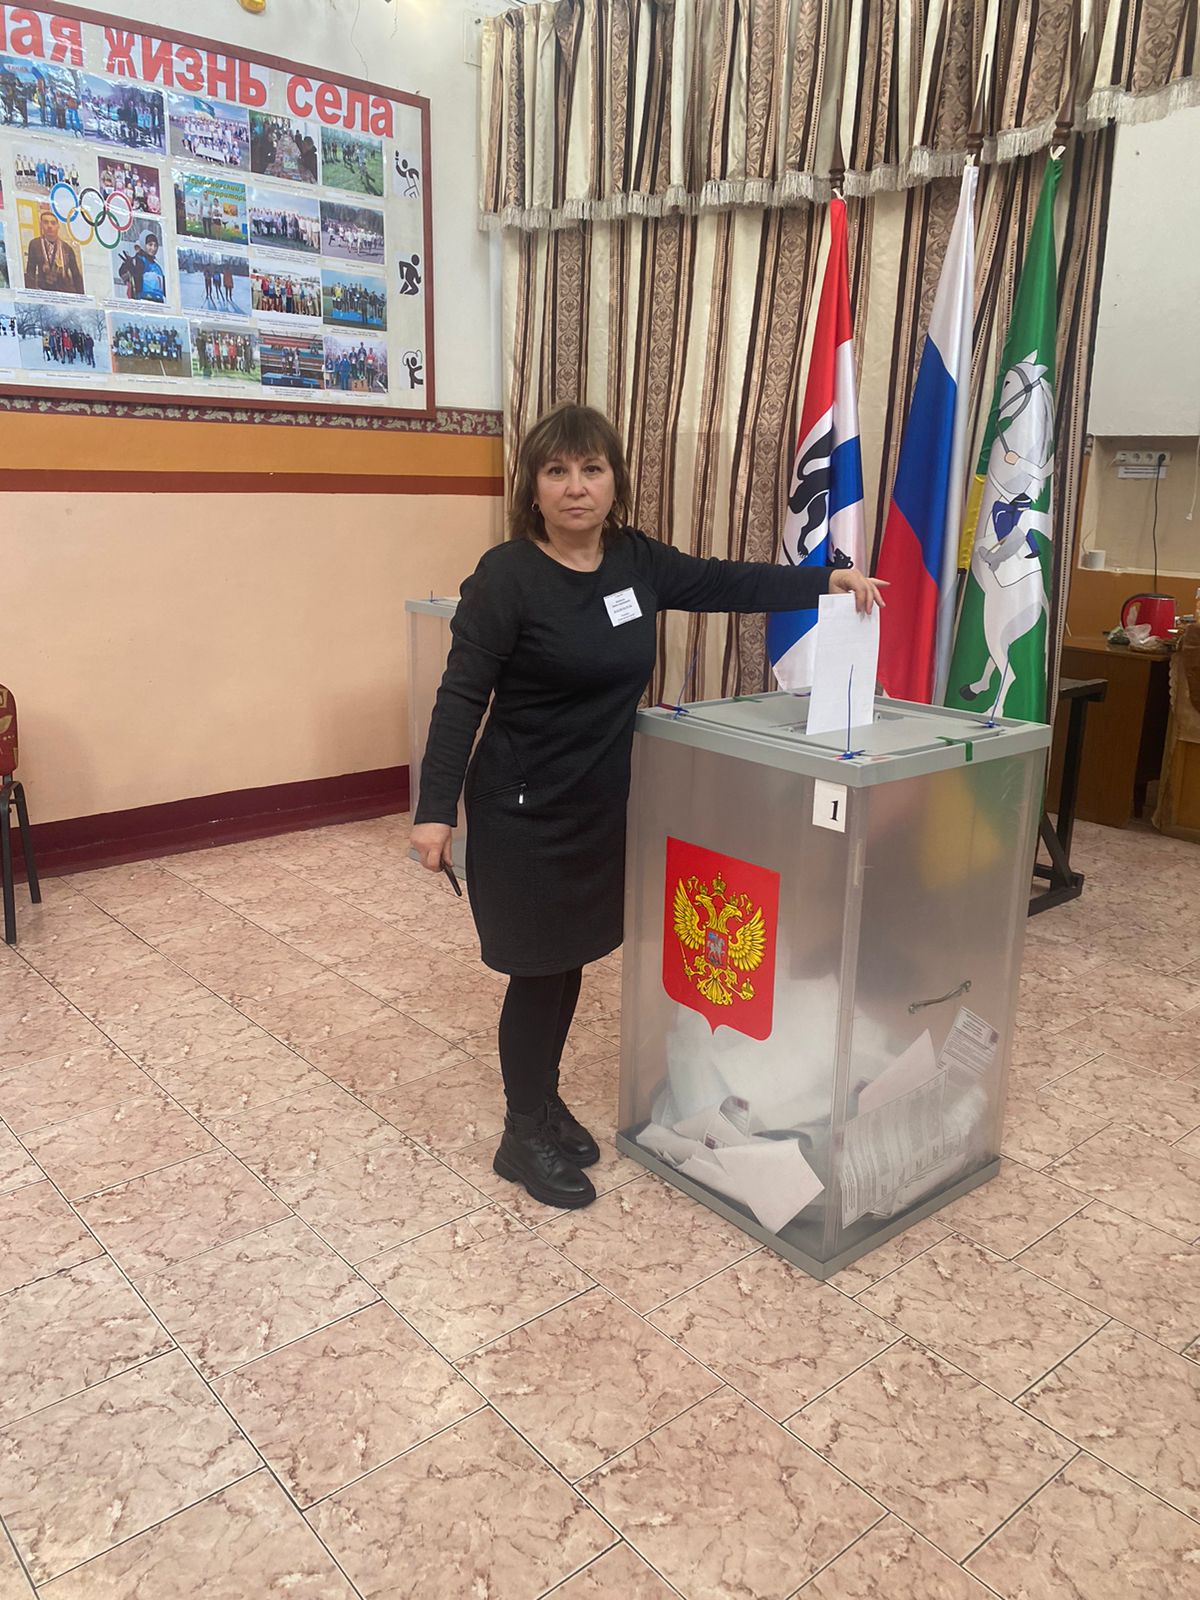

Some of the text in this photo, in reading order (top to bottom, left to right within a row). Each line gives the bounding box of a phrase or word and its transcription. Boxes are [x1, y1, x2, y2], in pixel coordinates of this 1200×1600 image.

[0, 4, 393, 138] ая жизнь села
[830, 800, 839, 822] 1
